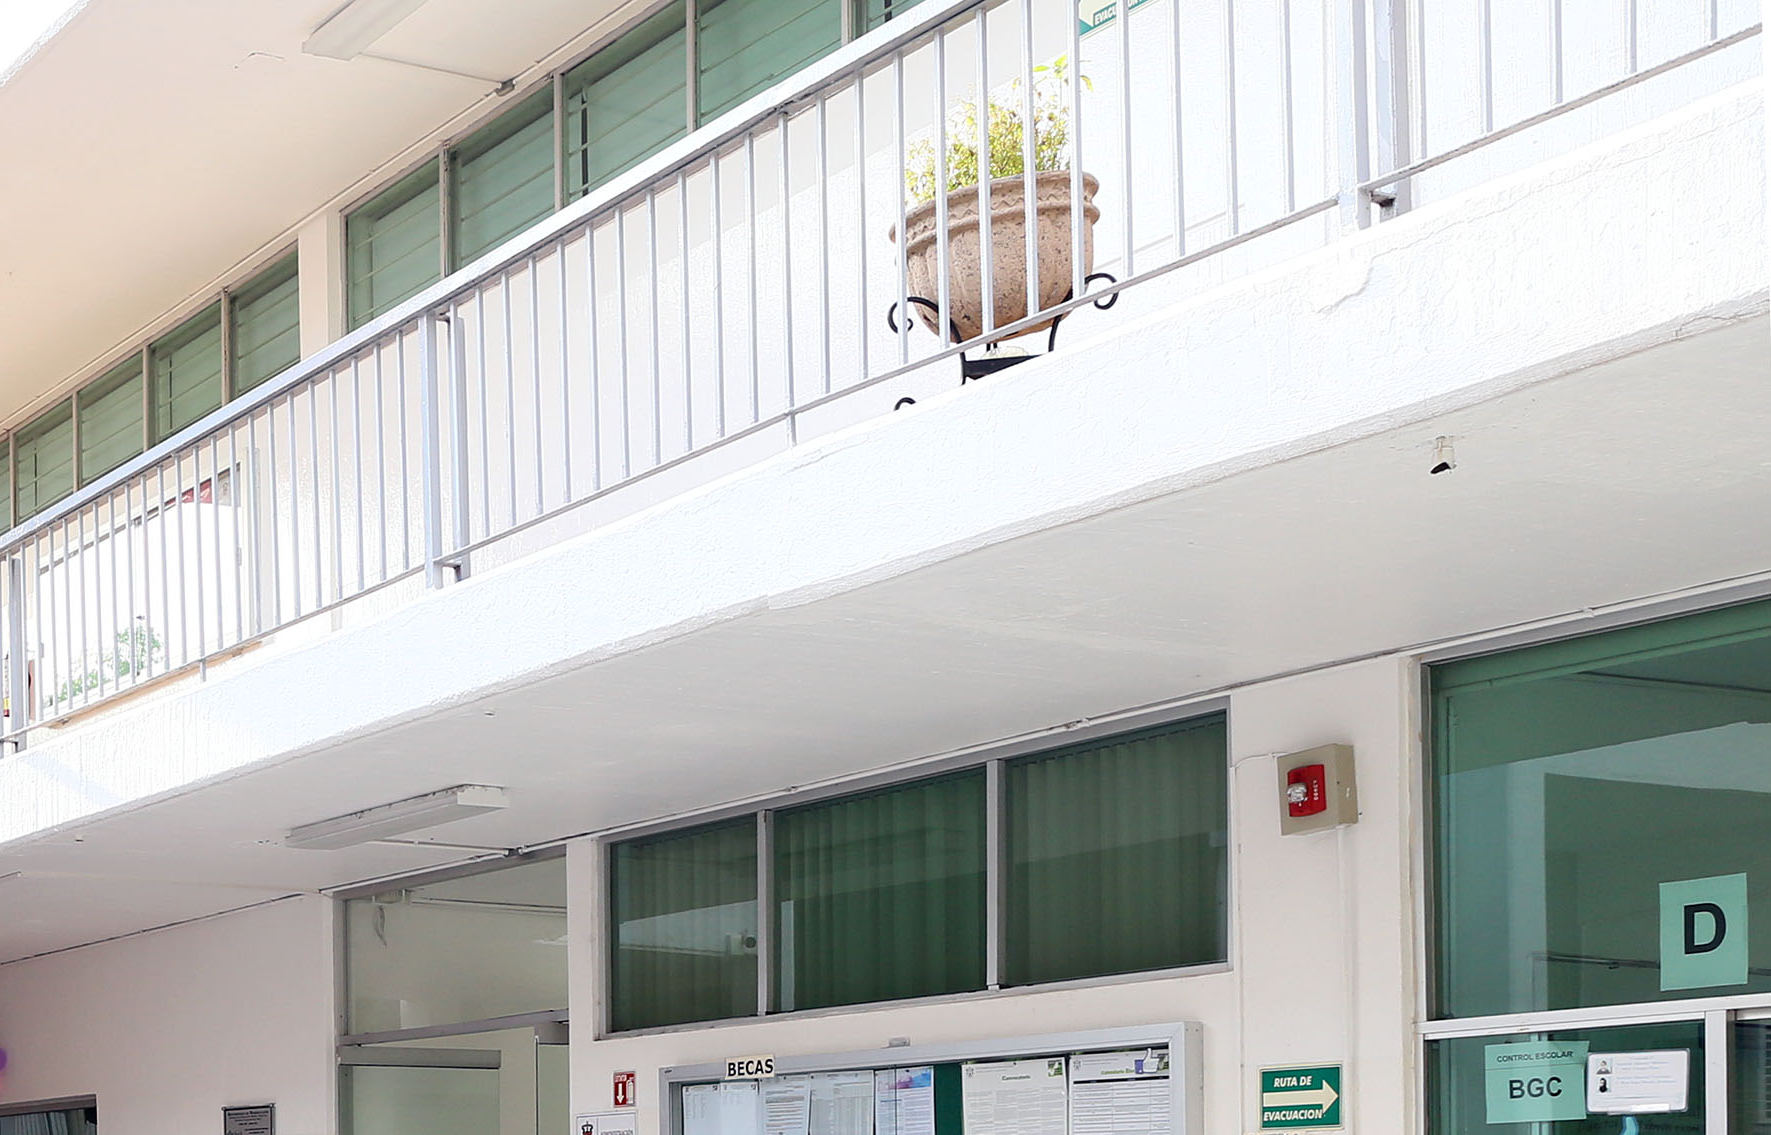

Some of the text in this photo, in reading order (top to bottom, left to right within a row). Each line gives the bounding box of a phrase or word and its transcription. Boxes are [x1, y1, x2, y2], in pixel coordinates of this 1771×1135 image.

[1684, 903, 1726, 955] D
[1497, 1050, 1573, 1063] CONTROL ESCOLAR
[728, 1059, 774, 1077] BECAS
[1273, 1075, 1313, 1088] RUTA DE
[1509, 1076, 1563, 1100] BGC
[1263, 1109, 1323, 1121] EVACUACION
